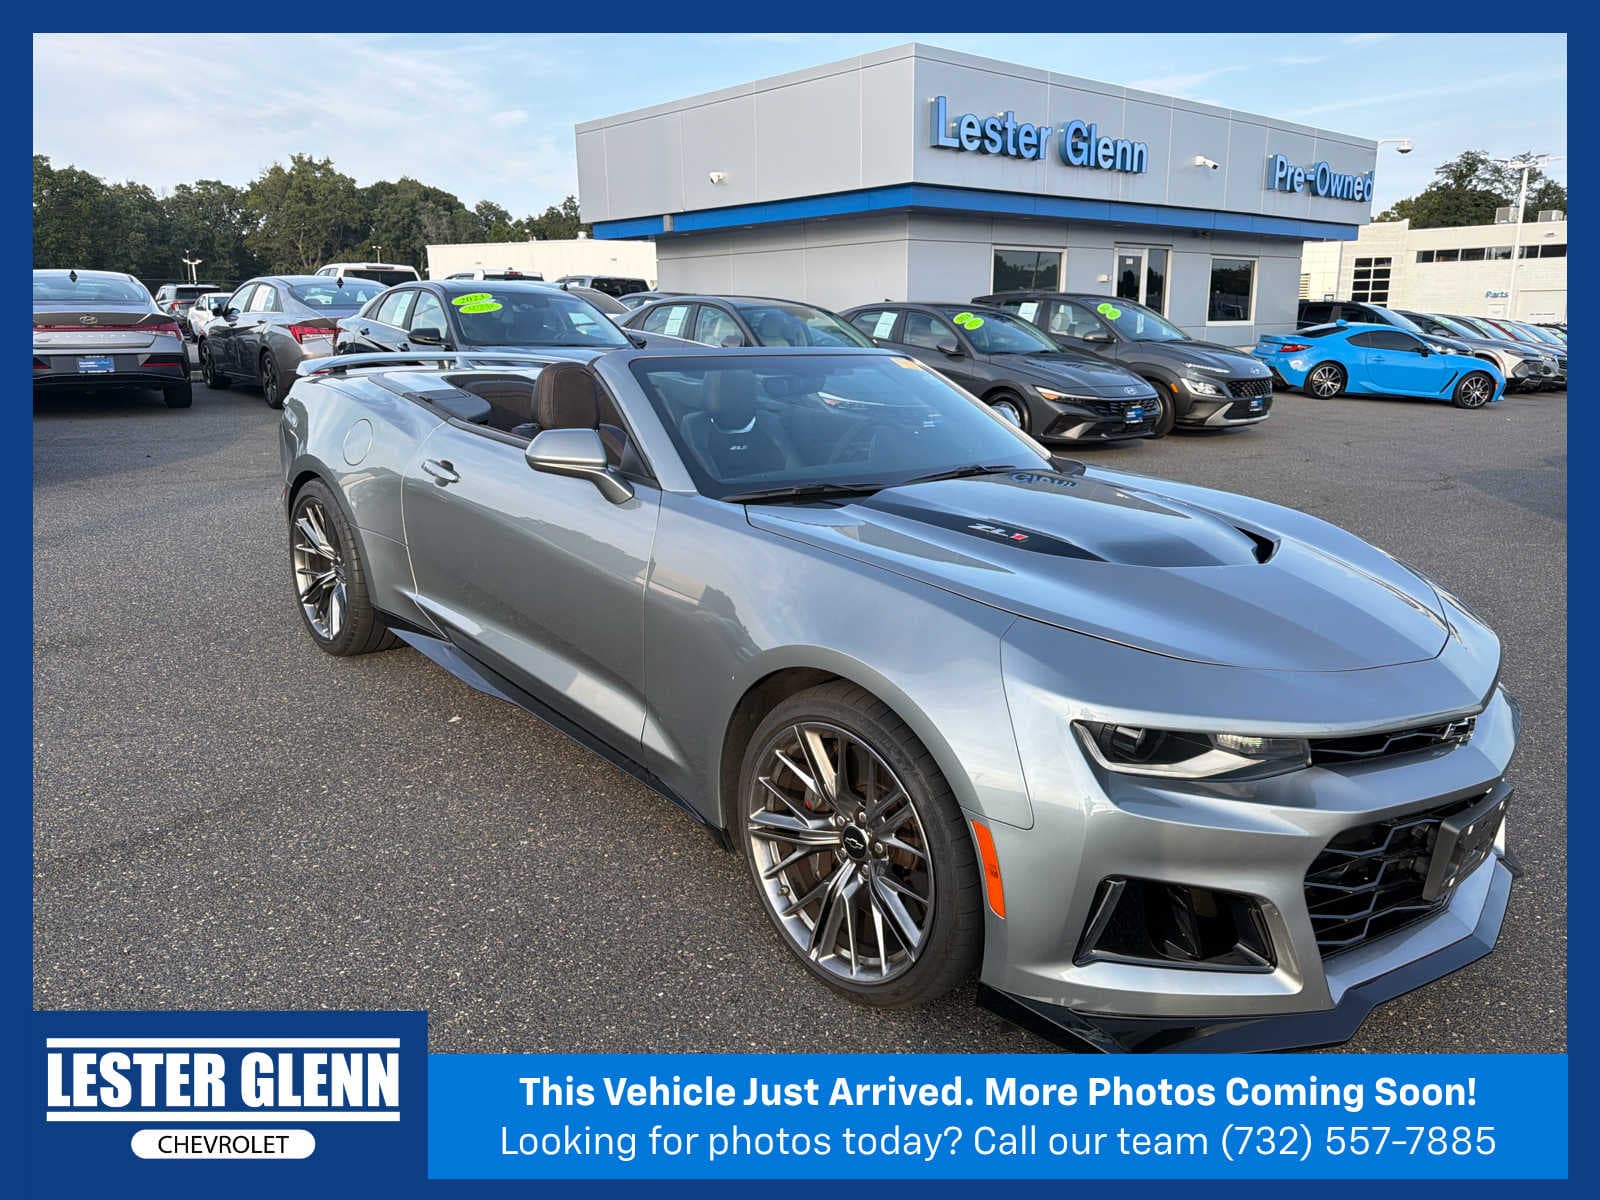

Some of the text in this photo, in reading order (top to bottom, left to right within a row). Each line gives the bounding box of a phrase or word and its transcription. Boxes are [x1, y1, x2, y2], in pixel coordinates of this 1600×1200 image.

[931, 95, 1149, 174] Lester Glenn
[1267, 153, 1374, 202] Pre-Owned
[1485, 290, 1509, 298] Parts
[968, 523, 1029, 541] ZL1
